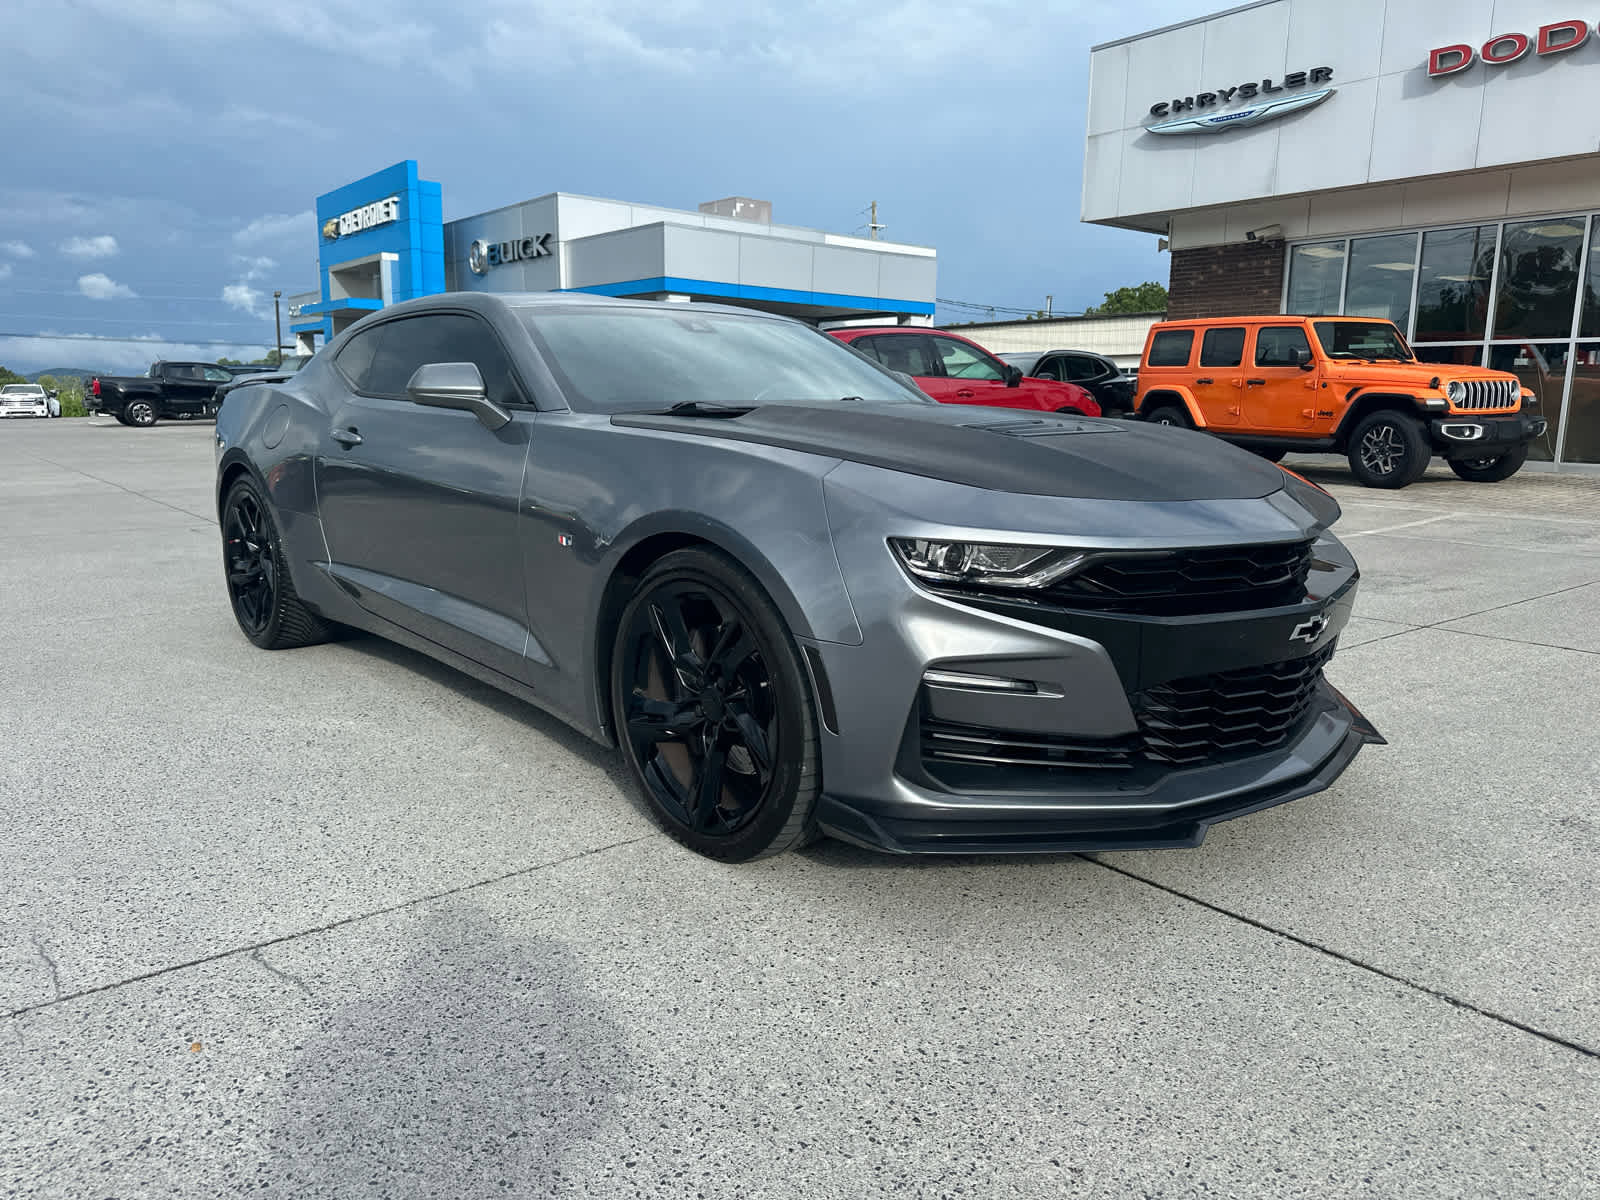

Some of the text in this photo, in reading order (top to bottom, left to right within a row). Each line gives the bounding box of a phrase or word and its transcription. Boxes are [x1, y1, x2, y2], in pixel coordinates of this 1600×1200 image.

[1428, 19, 1600, 77] DOD
[1150, 66, 1334, 117] CHRYSLER
[339, 196, 400, 236] CHEVROLET
[487, 233, 552, 265] BUICK
